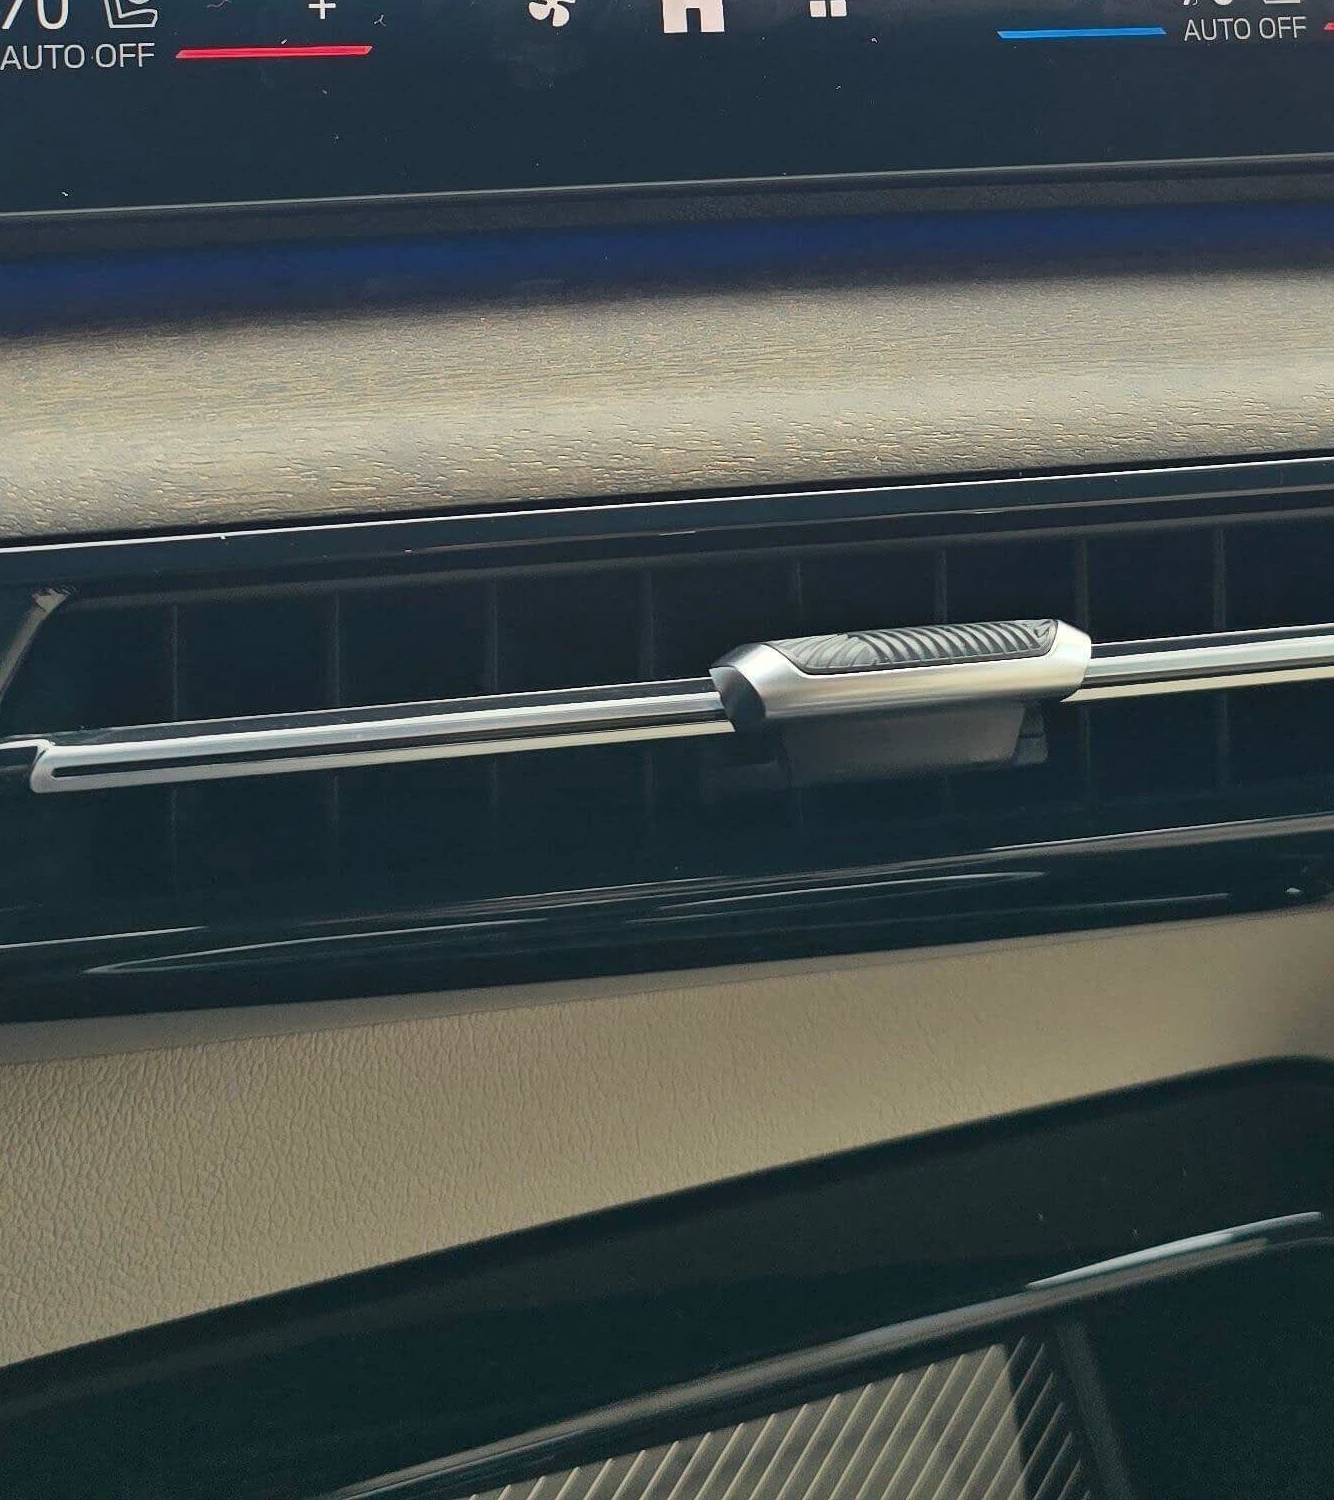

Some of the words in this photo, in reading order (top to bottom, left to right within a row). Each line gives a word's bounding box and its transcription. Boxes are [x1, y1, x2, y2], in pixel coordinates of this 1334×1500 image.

[1183, 18, 1252, 42] AUTO
[1258, 15, 1308, 40] OFF
[0, 44, 87, 73] AUTO
[95, 42, 156, 70] OFF
